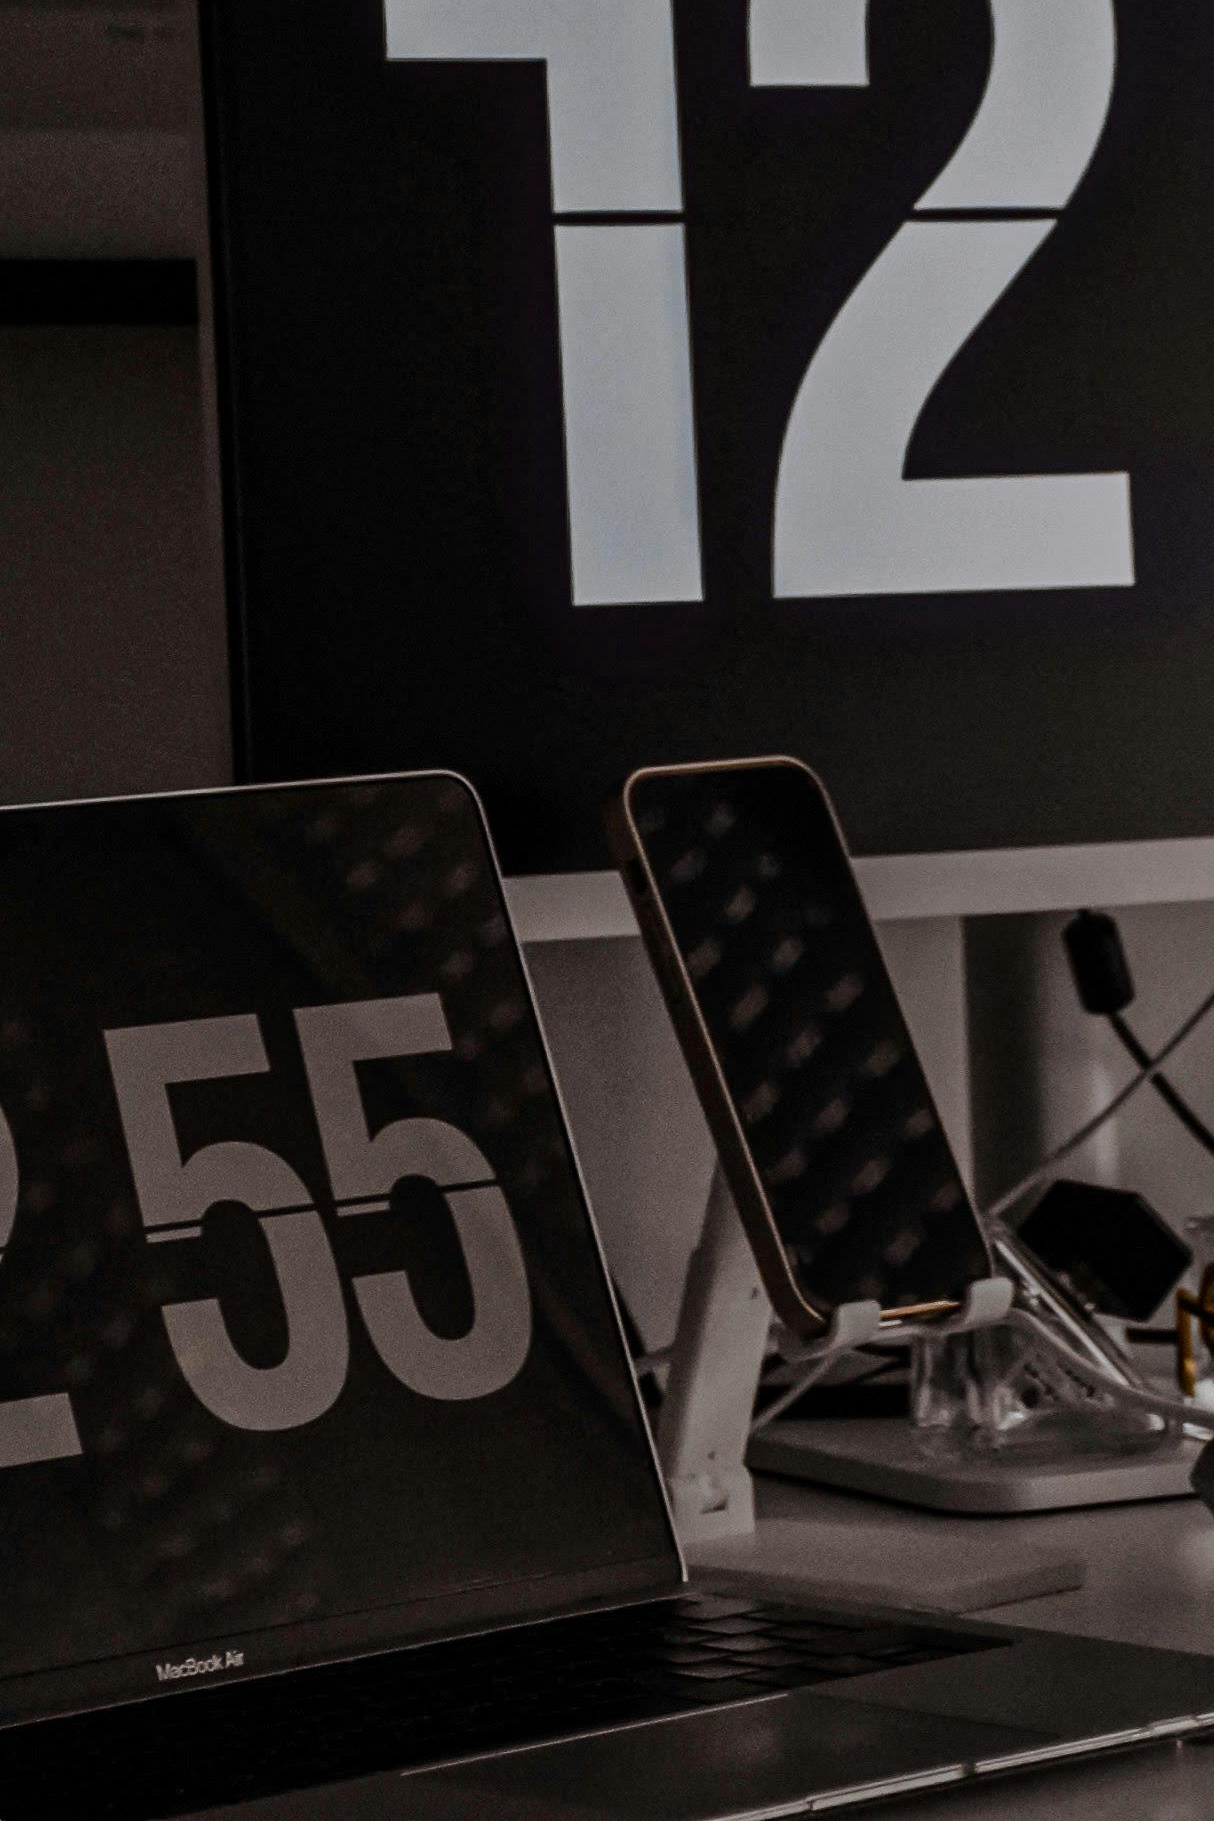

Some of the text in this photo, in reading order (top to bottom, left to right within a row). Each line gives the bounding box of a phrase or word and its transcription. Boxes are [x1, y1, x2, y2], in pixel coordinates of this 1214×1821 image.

[103, 992, 532, 1432] 55
[155, 1650, 245, 1681] MacBook Air
